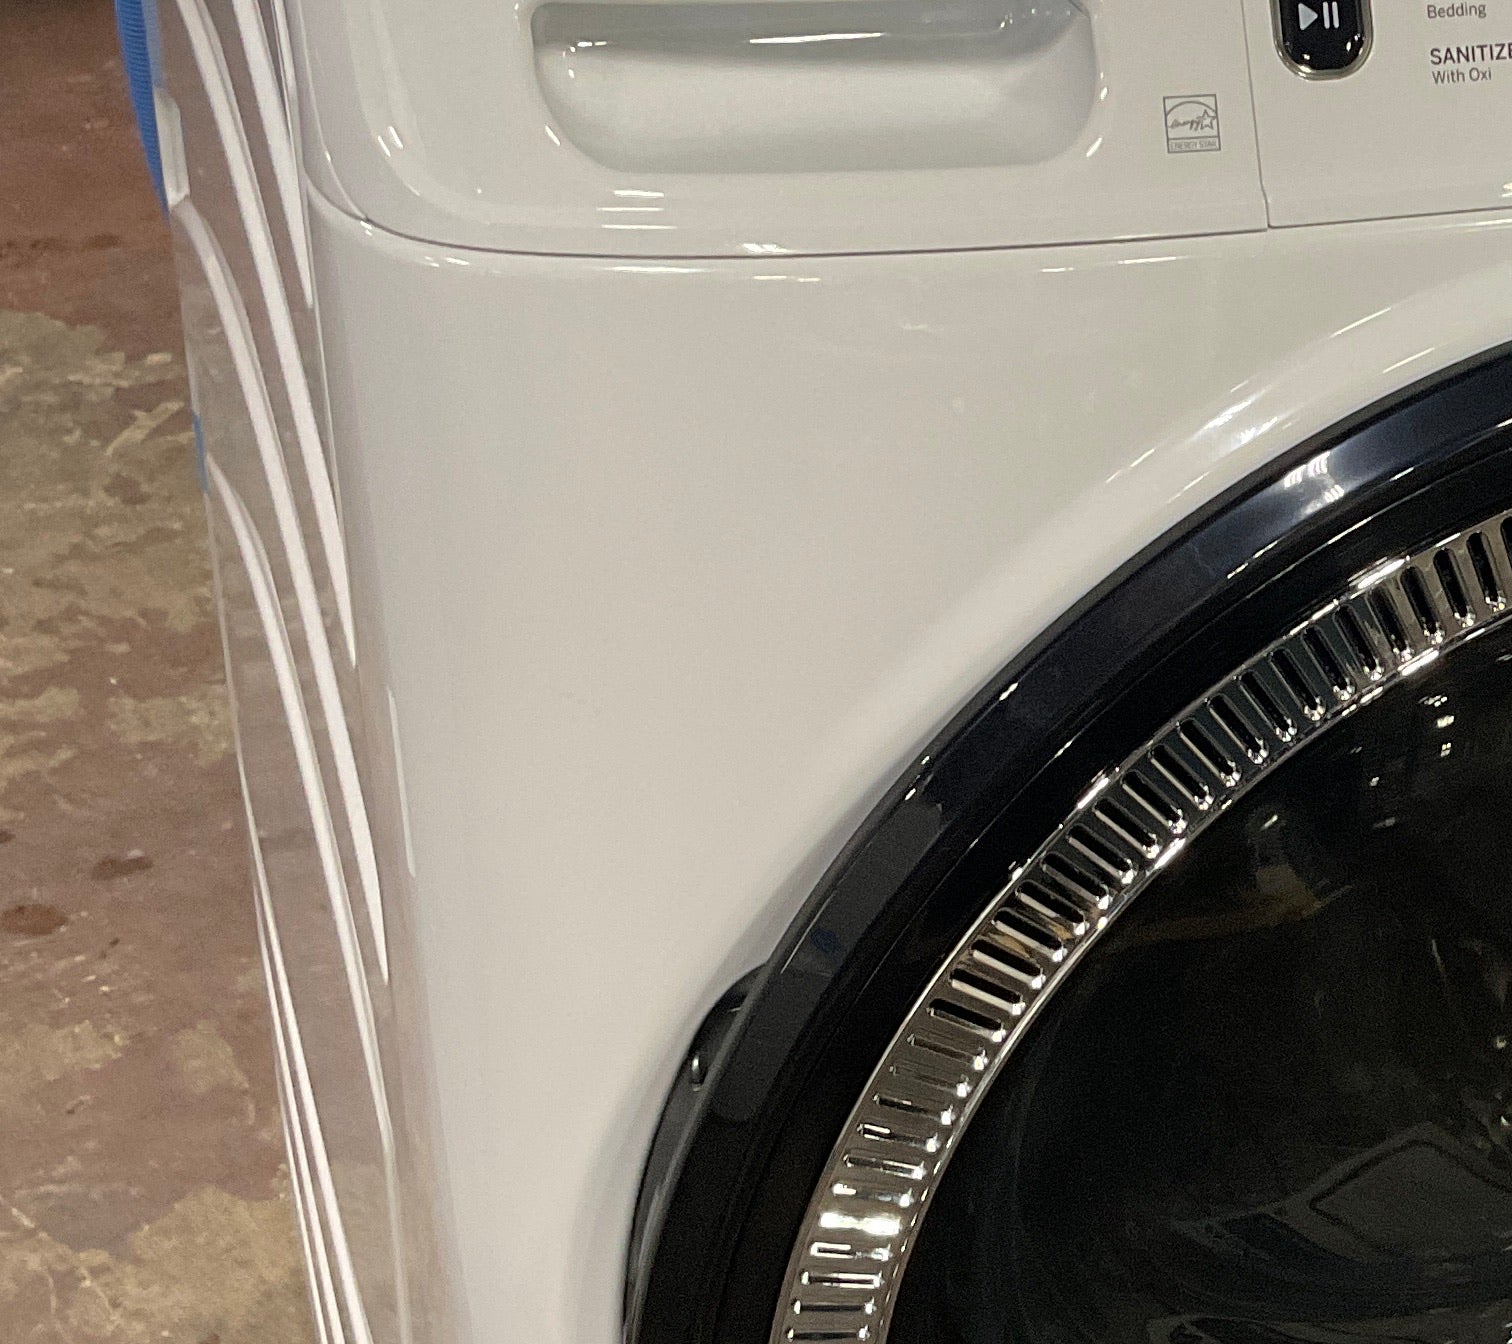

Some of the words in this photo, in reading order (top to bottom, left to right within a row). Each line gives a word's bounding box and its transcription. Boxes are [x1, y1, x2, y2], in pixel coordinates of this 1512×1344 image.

[1427, 2, 1487, 20] Bedding
[1432, 69, 1466, 85] With
[1469, 67, 1492, 82] Oxi
